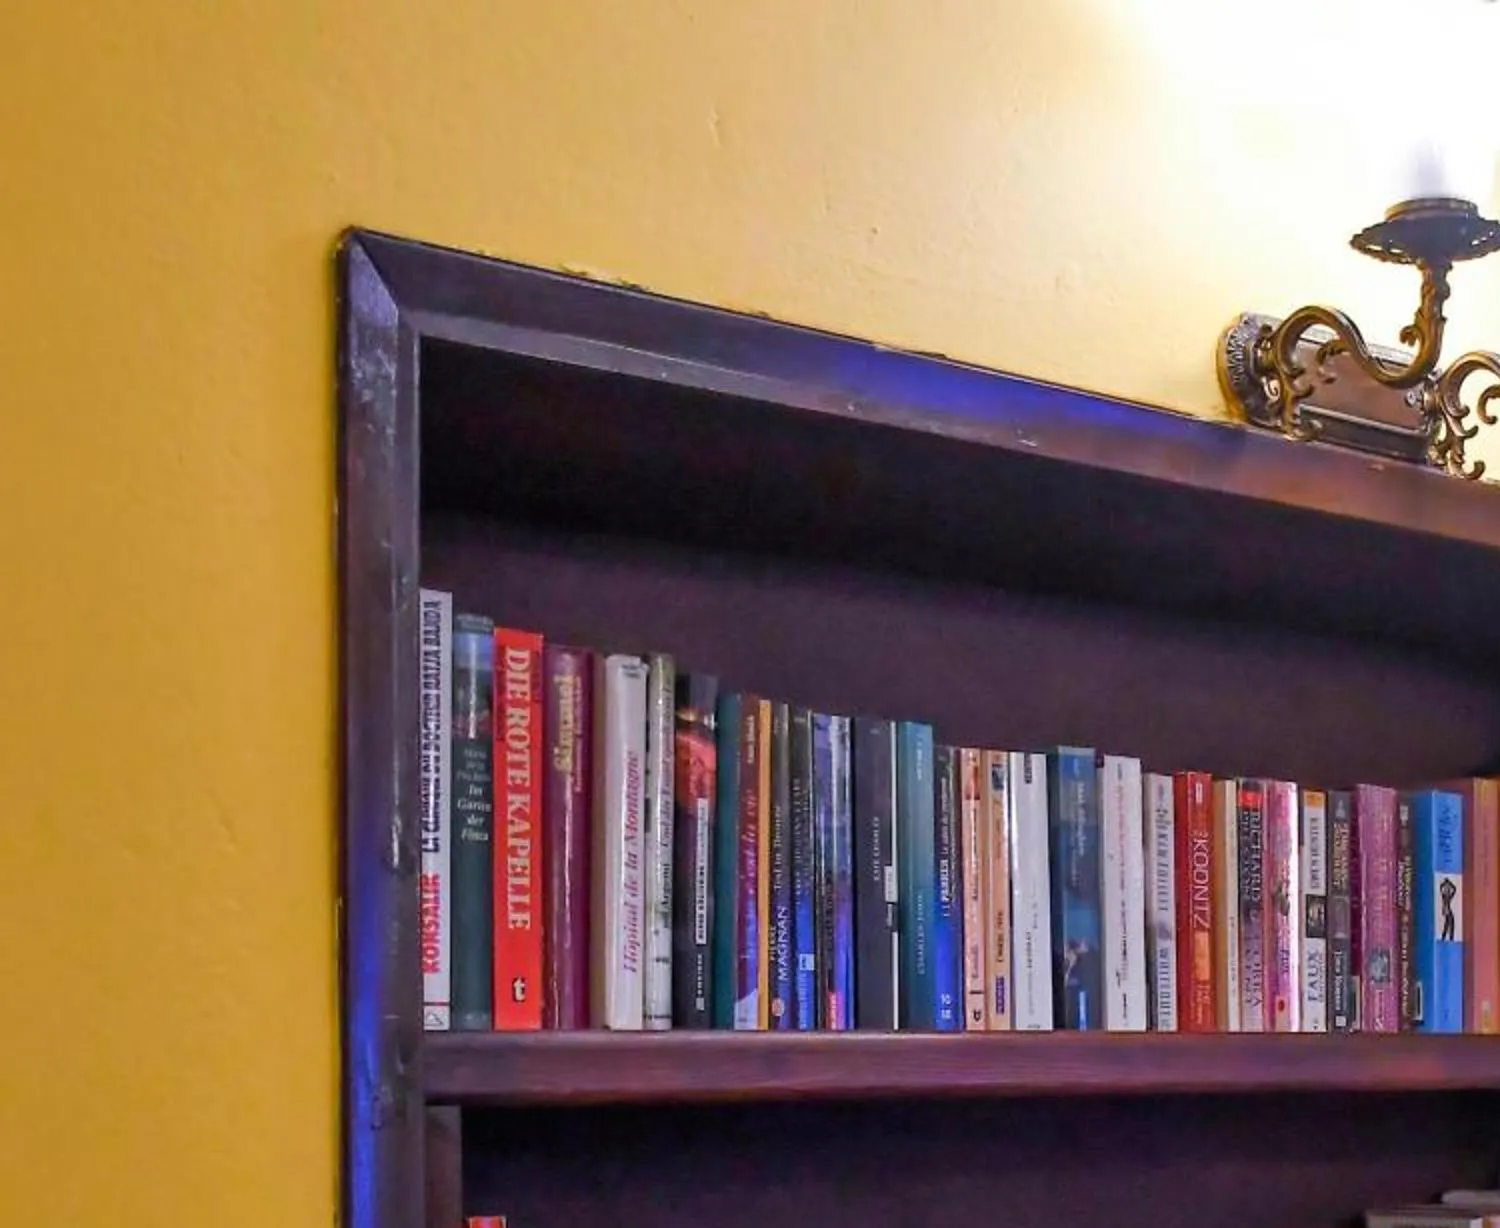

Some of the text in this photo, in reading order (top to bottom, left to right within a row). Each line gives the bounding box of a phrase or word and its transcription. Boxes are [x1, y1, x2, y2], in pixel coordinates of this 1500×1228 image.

[505, 646, 533, 931] DIE ROTE KAPELLE
[1193, 838, 1210, 929] KOONTZ
[777, 906, 788, 981] MAGNAN
